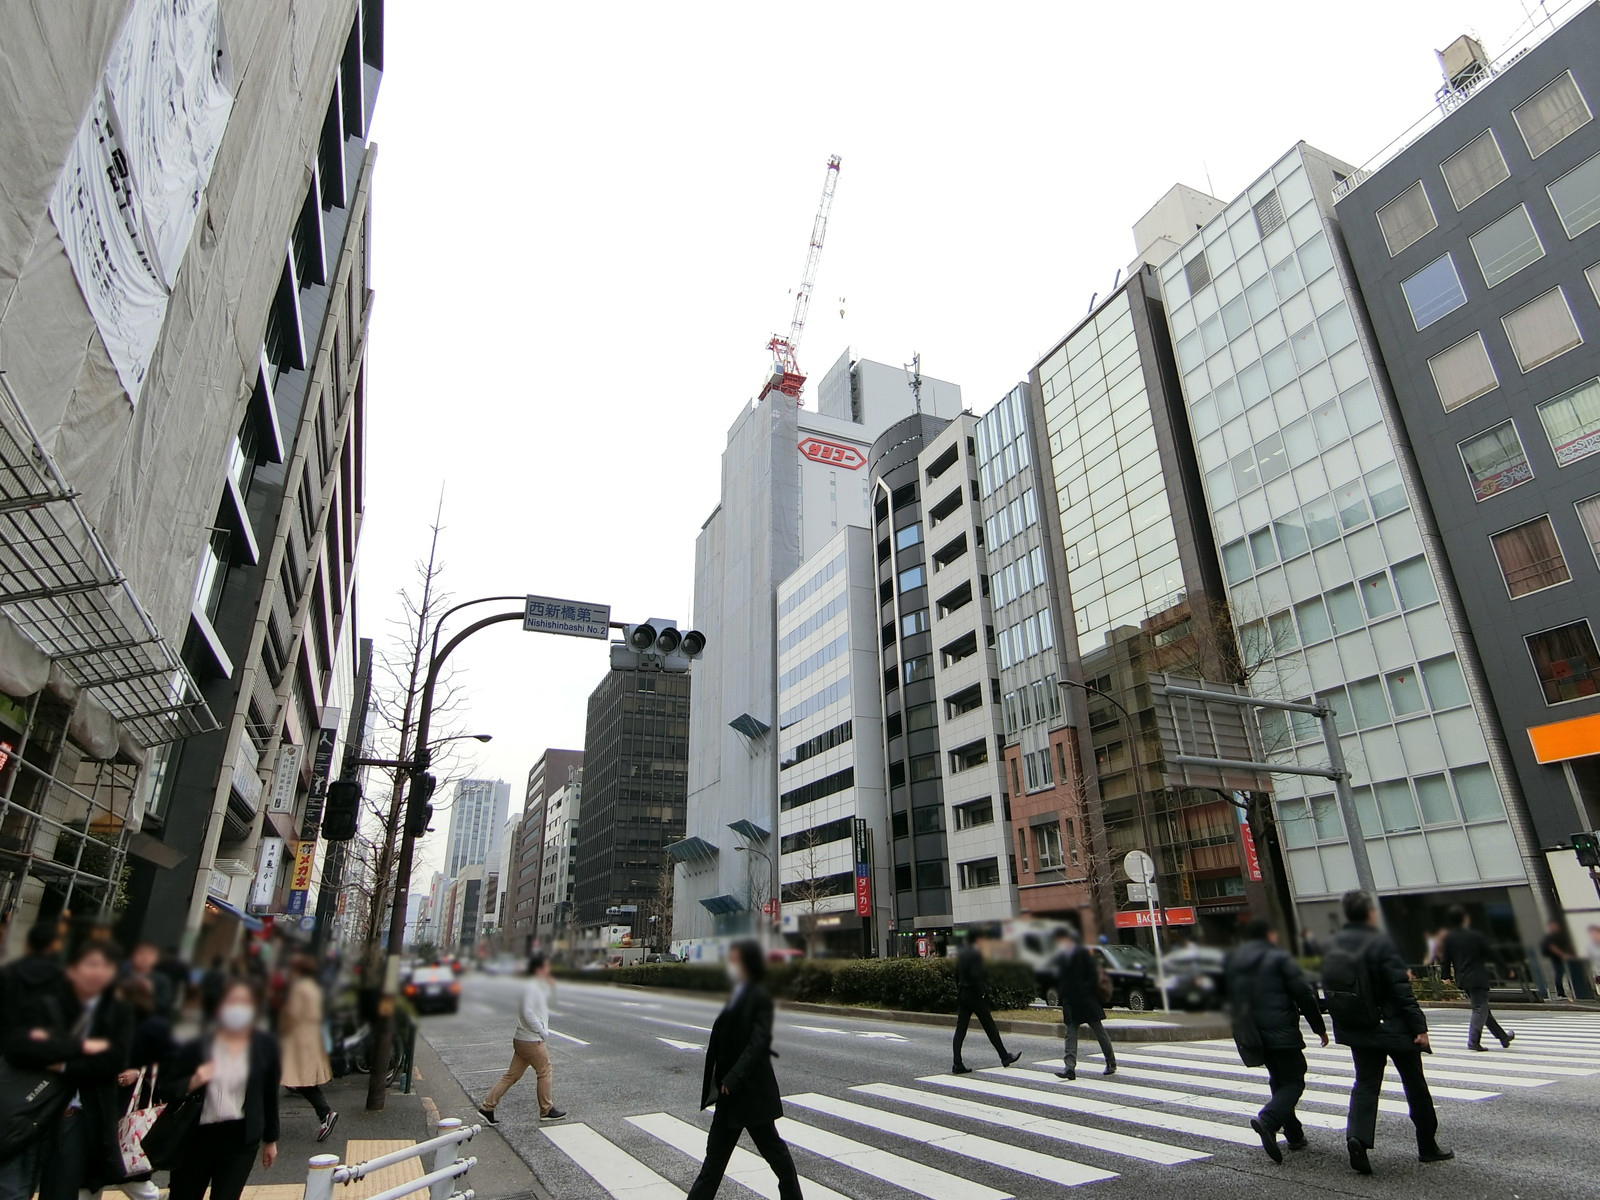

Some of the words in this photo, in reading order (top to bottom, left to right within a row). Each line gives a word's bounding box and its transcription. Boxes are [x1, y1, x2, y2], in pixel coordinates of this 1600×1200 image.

[1482, 482, 1495, 494] 5F
[529, 601, 606, 624] 西新橋第二
[527, 618, 585, 632] Nishishinbashi
[295, 855, 311, 887] メガネ
